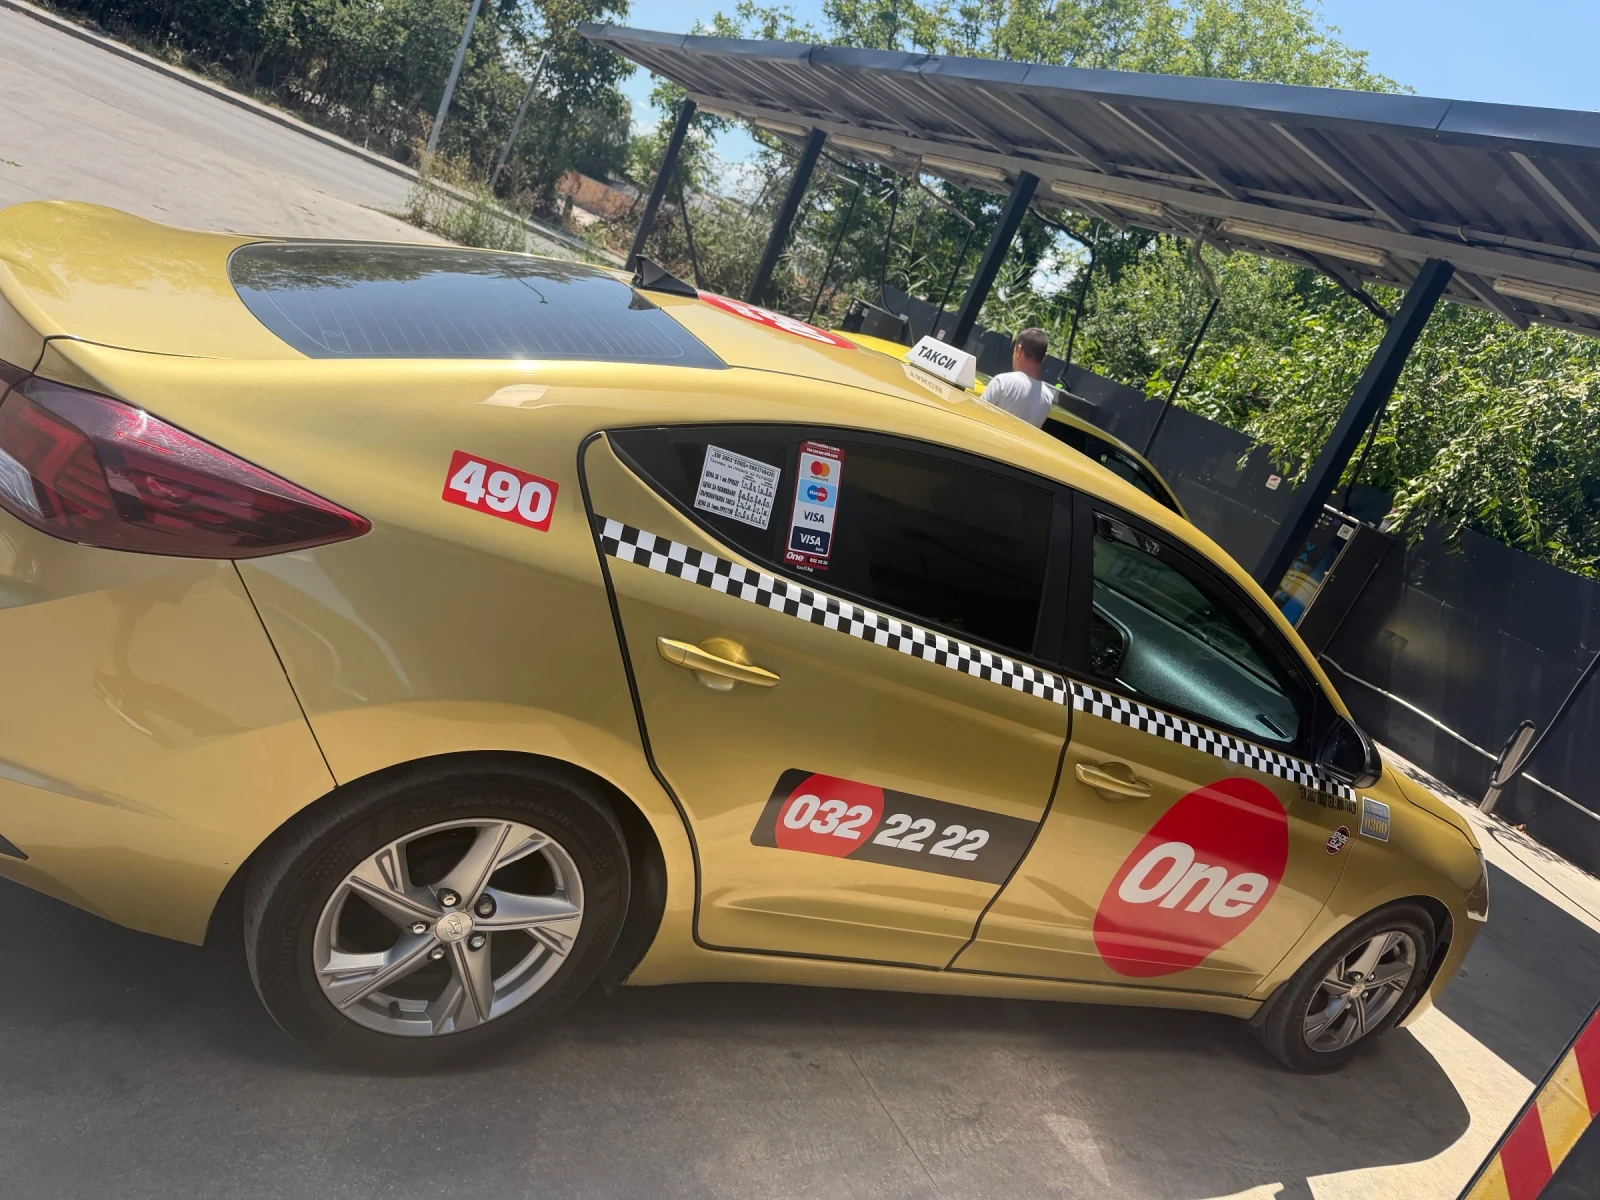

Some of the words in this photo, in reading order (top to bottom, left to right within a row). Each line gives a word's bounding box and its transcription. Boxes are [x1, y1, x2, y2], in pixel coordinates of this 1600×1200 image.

[918, 345, 957, 370] ТАКСИ
[449, 460, 552, 522] 490
[803, 509, 825, 524] VISA
[799, 532, 821, 547] VISA
[786, 551, 805, 562] One
[783, 794, 873, 840] 032
[872, 813, 937, 852] 22
[928, 824, 990, 861] 22
[1364, 816, 1387, 836] 0300
[1118, 841, 1269, 918] One
